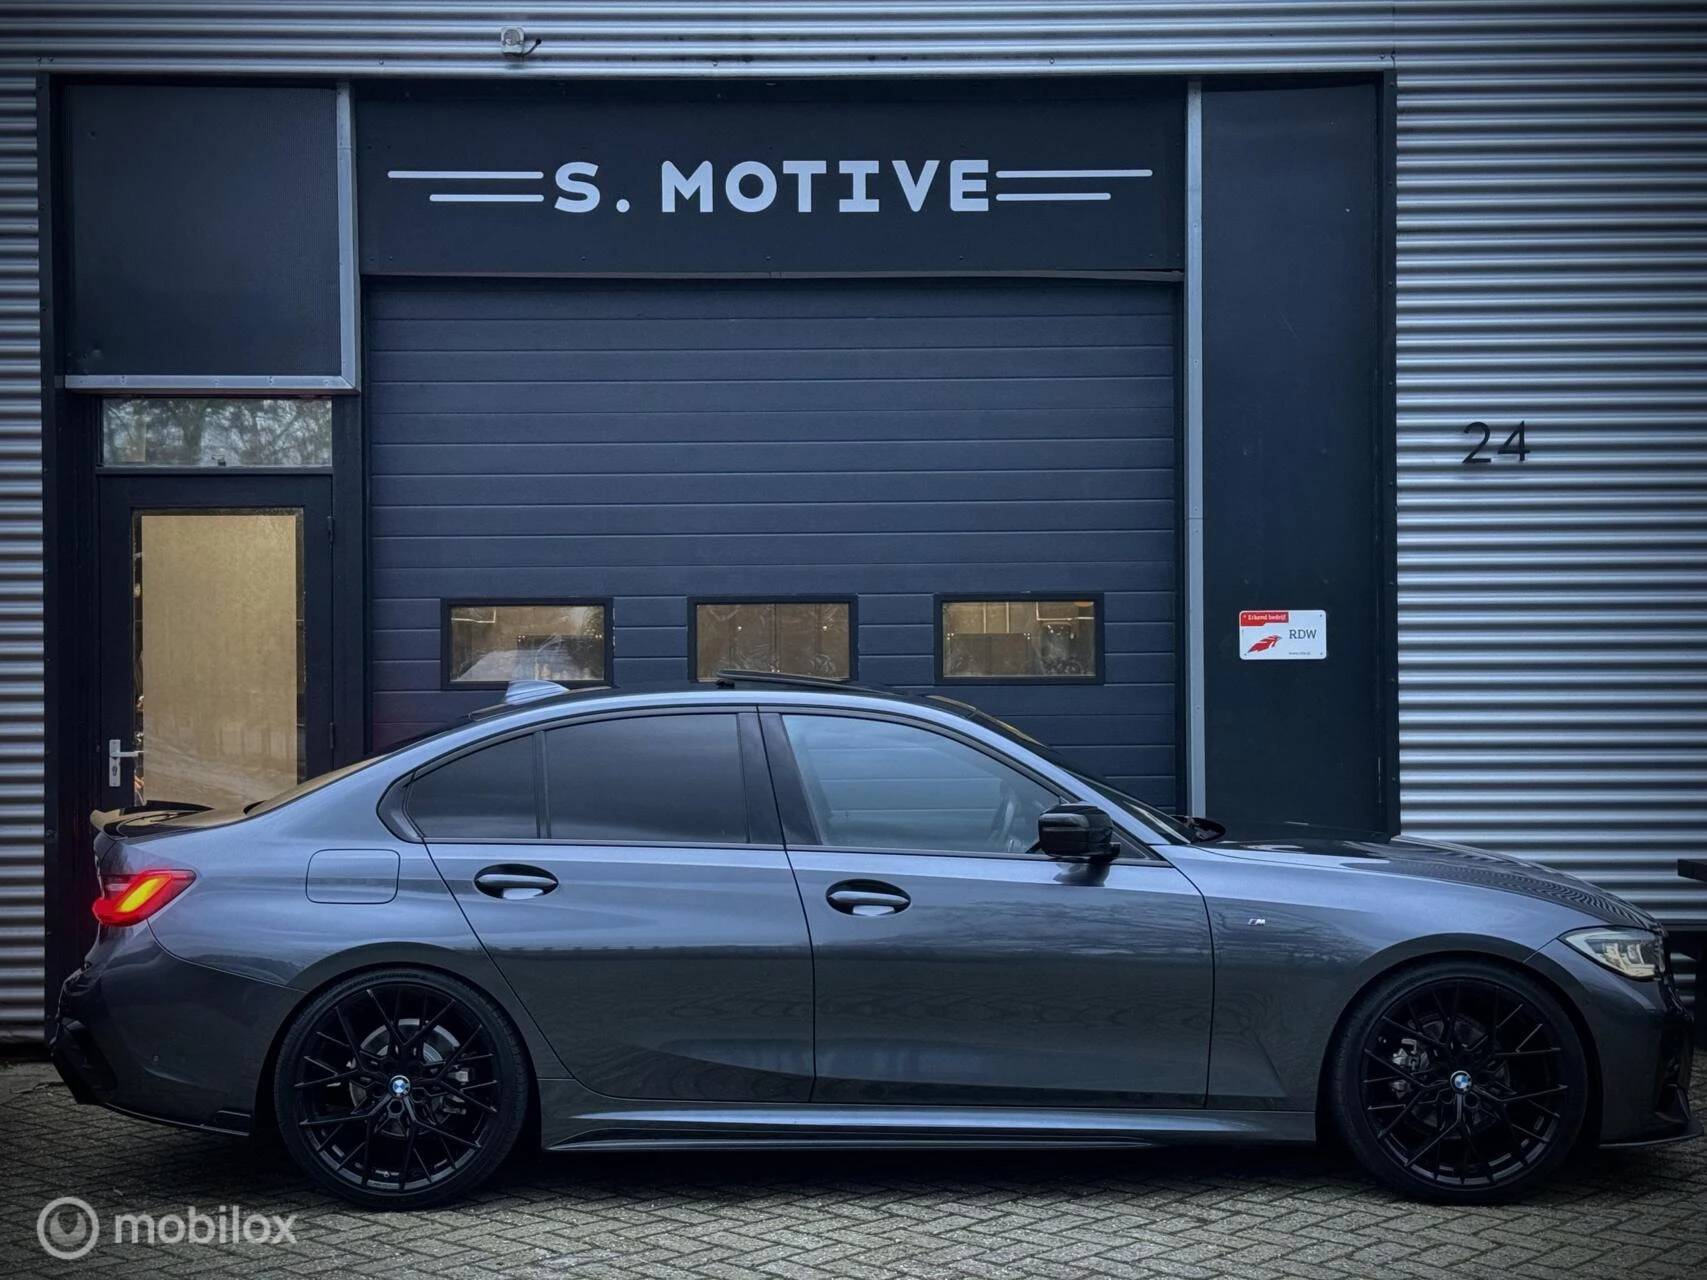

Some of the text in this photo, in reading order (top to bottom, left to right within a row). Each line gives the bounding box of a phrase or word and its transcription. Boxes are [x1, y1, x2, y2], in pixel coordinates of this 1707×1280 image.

[555, 160, 989, 213] S. MOTIVE
[1462, 420, 1531, 463] 24
[1289, 629, 1317, 639] RDW
